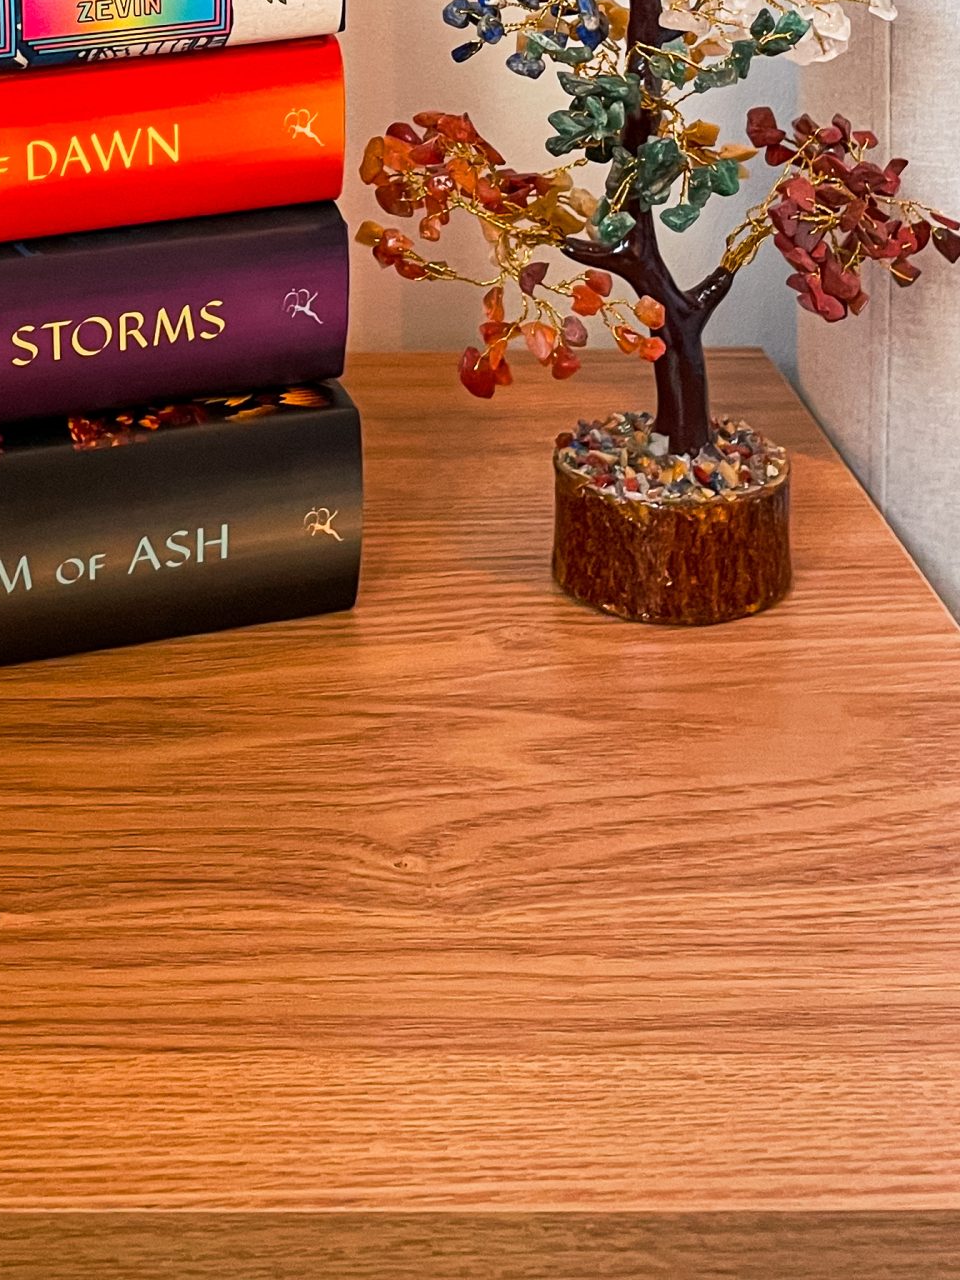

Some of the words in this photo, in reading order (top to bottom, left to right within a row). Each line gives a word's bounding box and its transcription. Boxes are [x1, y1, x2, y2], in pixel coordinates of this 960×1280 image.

[26, 123, 180, 182] DAWN
[11, 299, 227, 368] STORMS
[55, 553, 107, 585] OF
[128, 523, 229, 575] ASH
